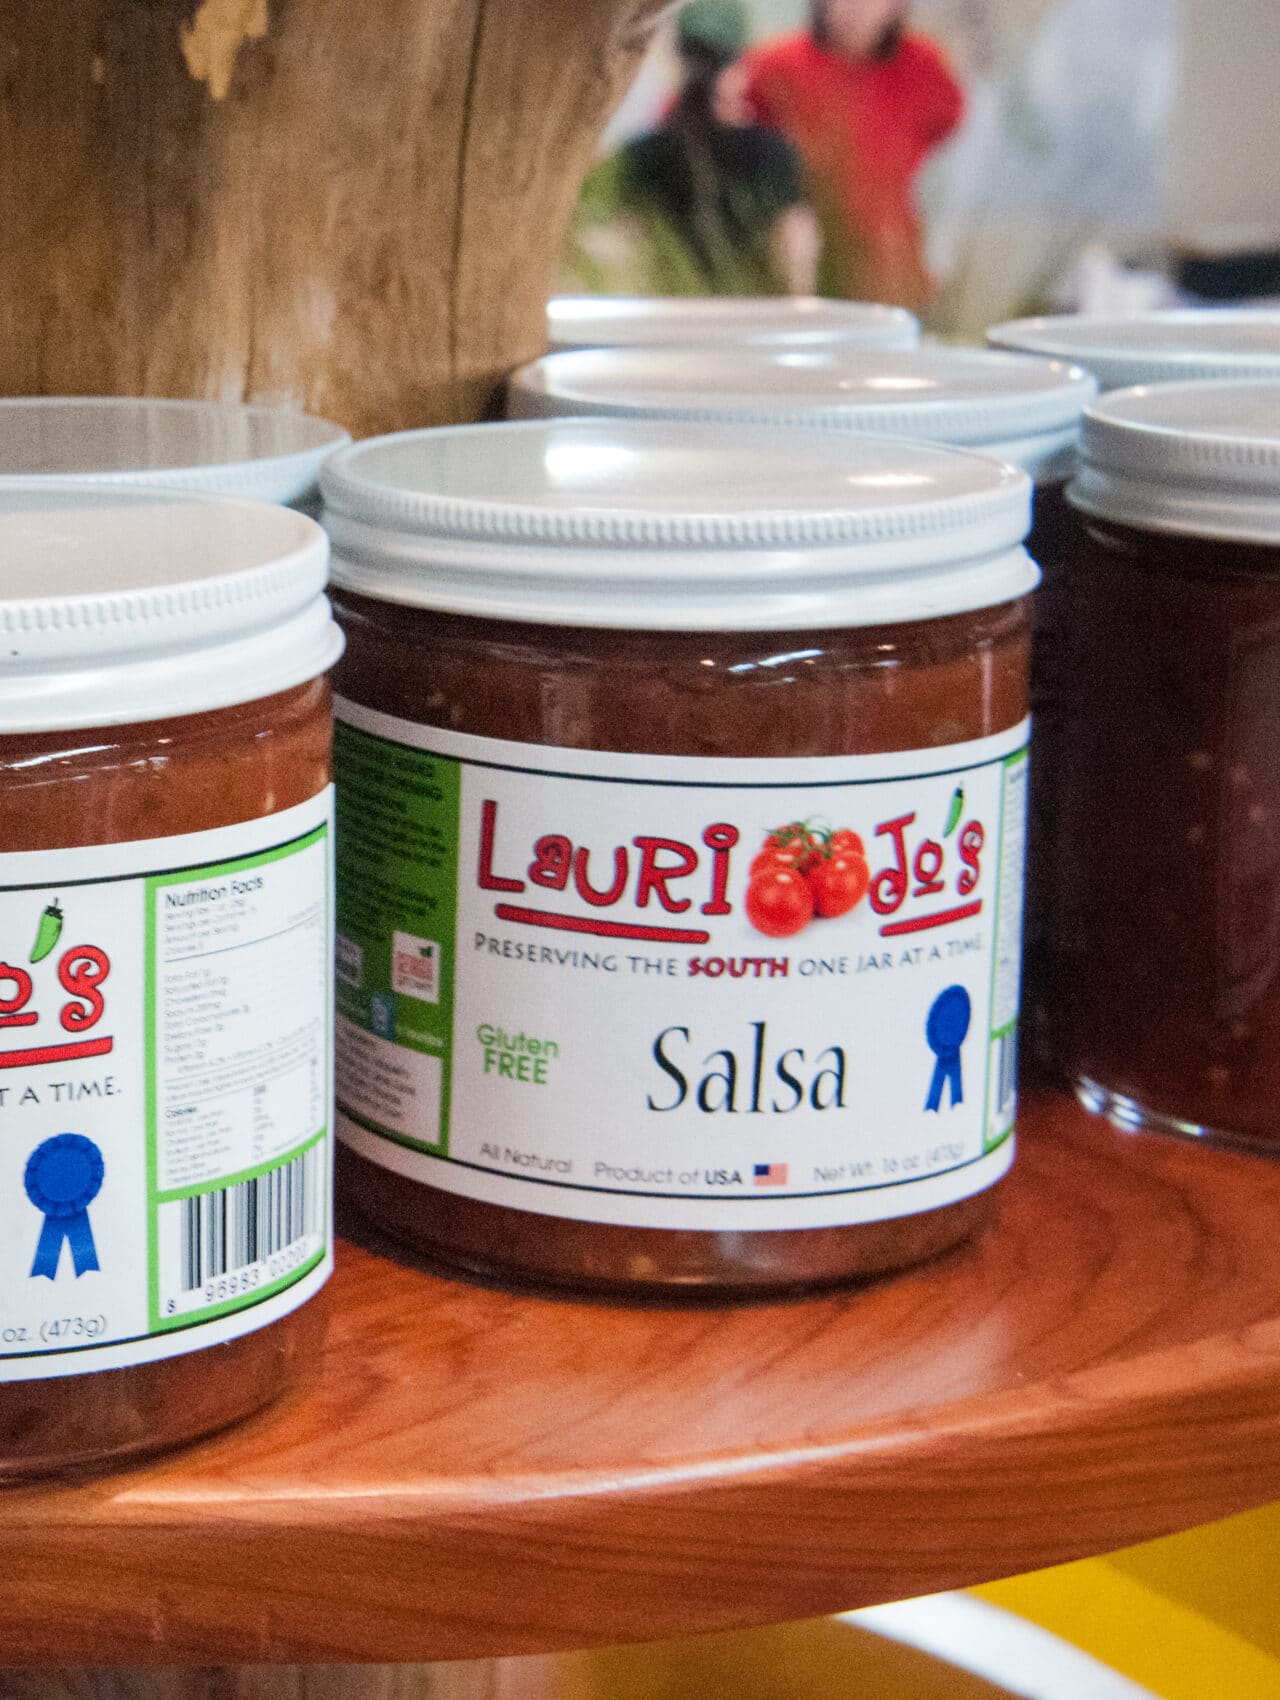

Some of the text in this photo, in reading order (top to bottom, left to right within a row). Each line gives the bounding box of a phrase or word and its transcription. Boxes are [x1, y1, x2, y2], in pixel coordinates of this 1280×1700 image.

[474, 932, 618, 974] PRESERVING
[625, 955, 679, 977] THE
[687, 956, 790, 979] SOUTH
[797, 957, 849, 978] ONE
[856, 952, 893, 975] JAR
[898, 947, 925, 968] AT
[927, 945, 943, 962] A
[476, 1022, 560, 1059] Gluten
[483, 1047, 550, 1086] FREE
[646, 1021, 848, 1115] Salsa
[19, 1084, 41, 1107] A
[504, 1147, 573, 1174] Natural
[593, 1160, 673, 1185] Product
[703, 1170, 743, 1187] USA
[39, 1314, 108, 1343] (473g)
